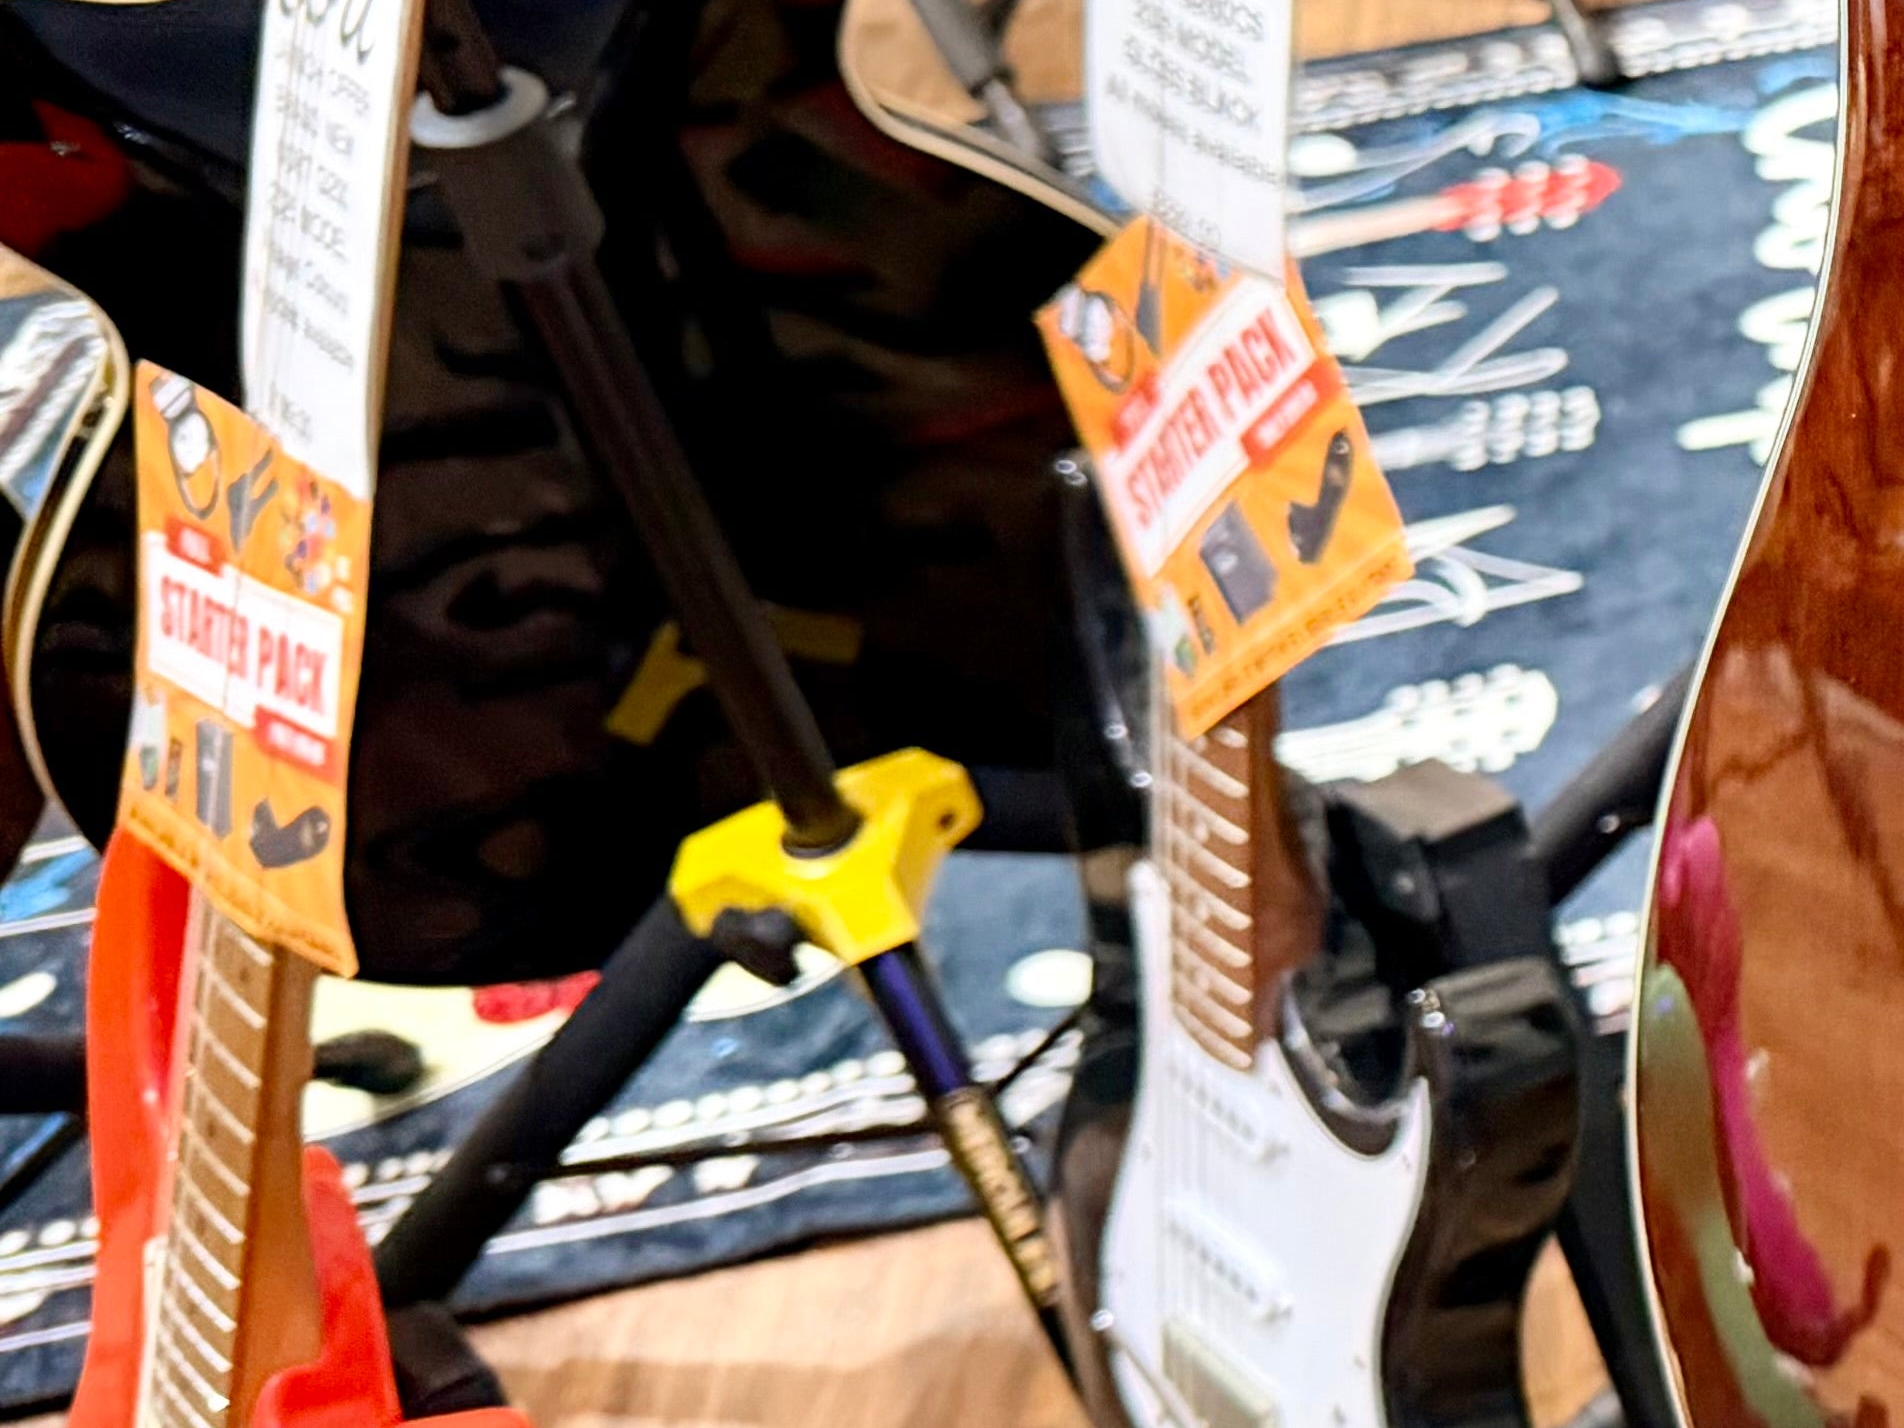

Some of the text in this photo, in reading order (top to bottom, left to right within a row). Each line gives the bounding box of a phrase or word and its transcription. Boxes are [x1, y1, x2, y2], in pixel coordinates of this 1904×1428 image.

[1124, 386, 1224, 531] STARTER
[1205, 307, 1298, 424] PACK
[160, 573, 330, 718] STARTER PACK
